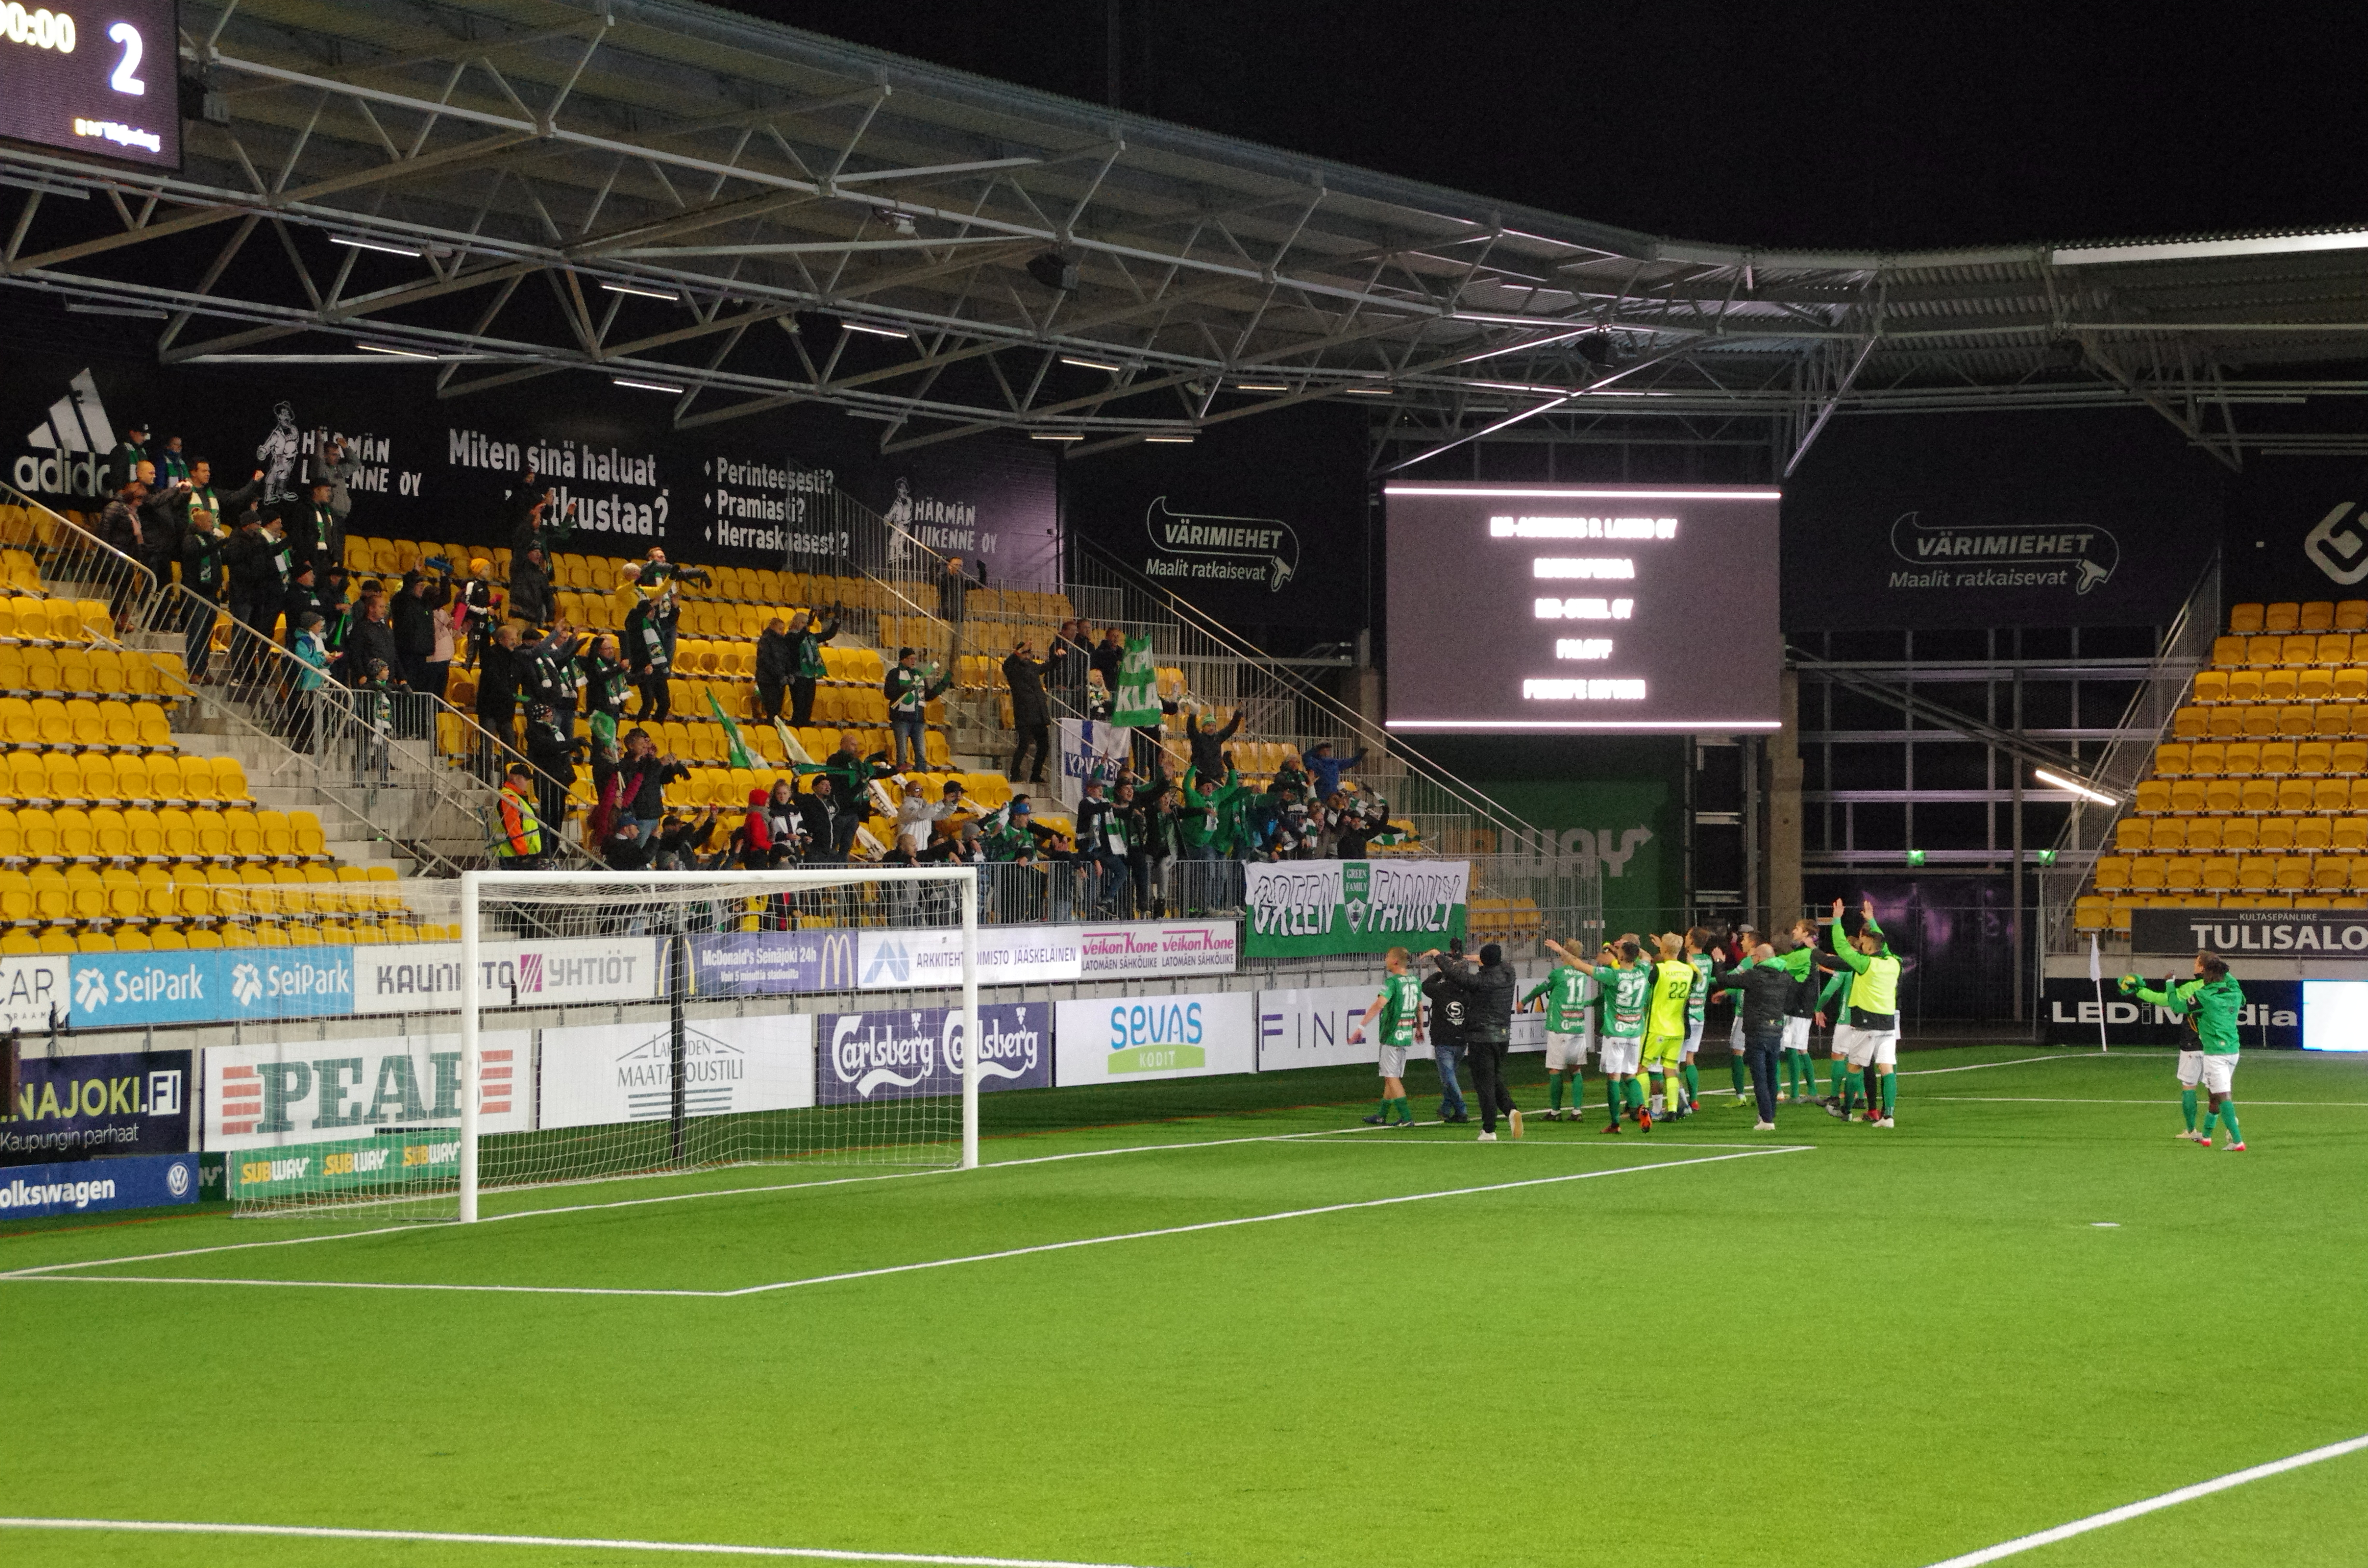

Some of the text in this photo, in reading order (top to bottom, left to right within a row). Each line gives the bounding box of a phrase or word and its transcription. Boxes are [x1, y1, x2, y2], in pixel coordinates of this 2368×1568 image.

[108, 22, 144, 96] 2
[449, 429, 656, 487] Miten sinä haluat
[399, 471, 422, 497] OY
[717, 457, 834, 494] Perinteesesti?
[506, 486, 669, 537] tkustaa?
[717, 489, 805, 524] Pramiasti?
[914, 496, 976, 527] HÄRMÄN
[718, 519, 849, 556] Herraskaasest?
[982, 532, 998, 553] OY
[1165, 518, 1283, 550] VÄRIMIEHET
[1917, 531, 2094, 556] VÄRIMIEHET
[1145, 558, 1267, 581] Maalit ratkaisevat
[1888, 568, 2068, 588] Maalit ratkaisevat
[1069, 752, 1095, 775] KPV
[1346, 869, 1367, 879] GREEN
[1346, 882, 1368, 892] FAMILY
[1253, 871, 1339, 936] GREEN
[1368, 870, 1461, 933] FAMILY
[2239, 913, 2318, 922] KULTASEPÄNLIIKE
[1124, 932, 1158, 954] Kone
[1202, 929, 1234, 950] Kone
[2190, 924, 2368, 950] TULISALO
[549, 949, 637, 987] YHTIÖT
[702, 946, 816, 967] McDonald's Seinäjoki 24h
[1014, 943, 1076, 966] JÄÄSKELÄINEN
[1082, 951, 1234, 971] LATOMÄEN SÄHKÖLIIKE LATOMÄEN SÄHKÖLIIKE
[114, 963, 204, 1003] SeiPark
[267, 962, 350, 997] SeiPark
[377, 960, 516, 994] KAUNITO
[1566, 976, 1584, 1004] 11
[1667, 981, 1688, 999] 22
[1402, 982, 1418, 1011] 16
[1616, 978, 1646, 1008] 27
[832, 1008, 1038, 1083] Carlsberg Calsberg
[1139, 1051, 1176, 1067] KODIT
[618, 1058, 743, 1088] MAATAOUSTILI
[0, 1123, 140, 1153] Kaupungin parhaat
[323, 1148, 389, 1176] SUBWAY
[402, 1140, 461, 1167] SUBWAY
[240, 1156, 310, 1185] SUBWAY
